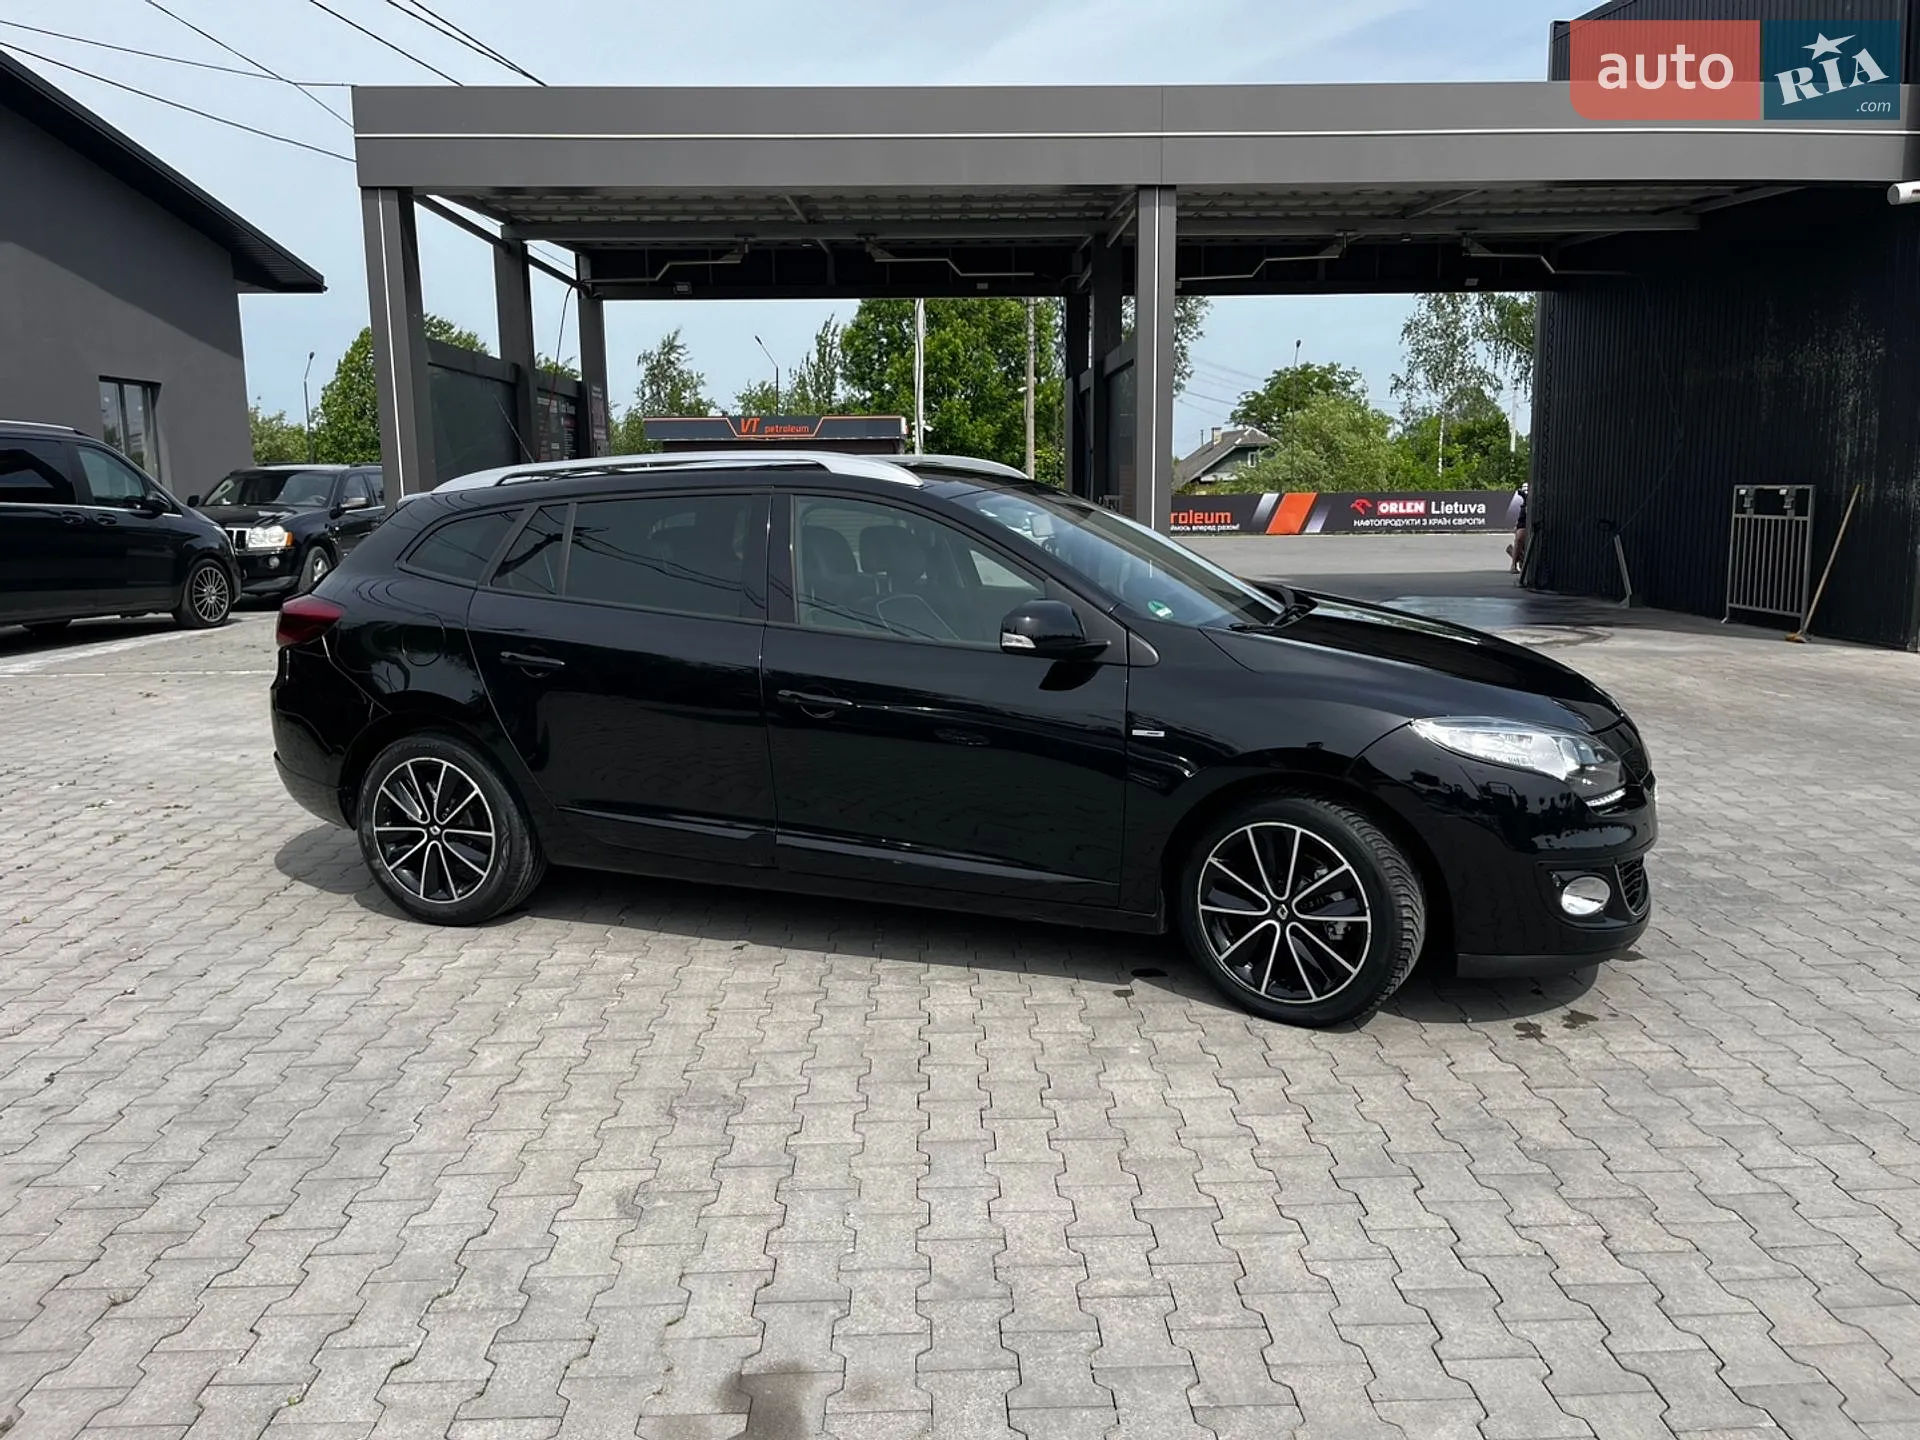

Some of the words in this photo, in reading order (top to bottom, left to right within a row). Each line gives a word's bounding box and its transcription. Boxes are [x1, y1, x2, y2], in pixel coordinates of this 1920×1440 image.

[740, 417, 760, 433] VT
[764, 424, 809, 435] petroleum
[1379, 501, 1425, 514] ORLEN
[1430, 501, 1486, 514] Lietuva
[1170, 509, 1232, 524] roleum
